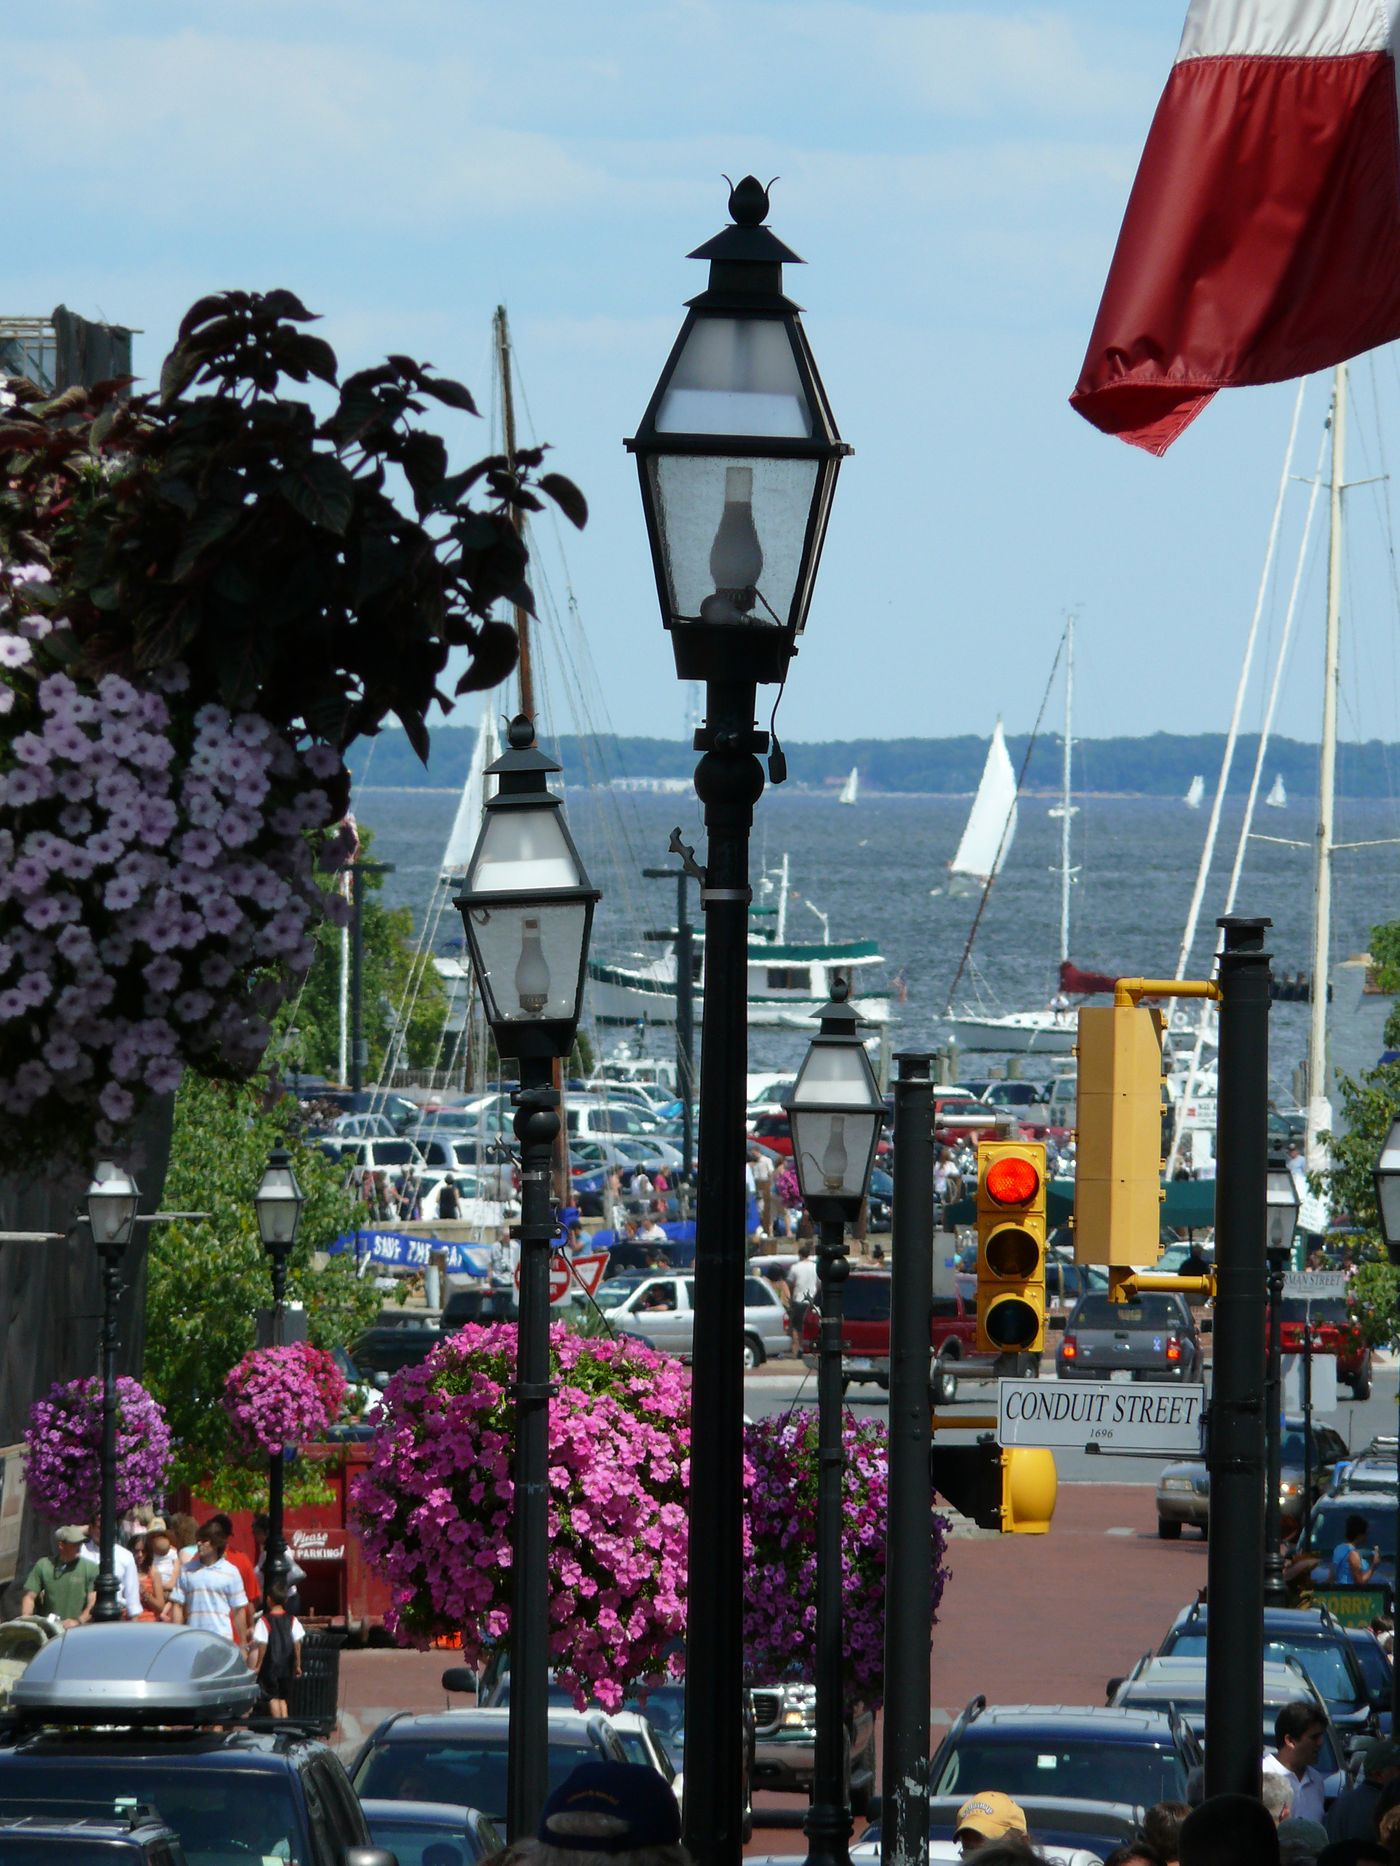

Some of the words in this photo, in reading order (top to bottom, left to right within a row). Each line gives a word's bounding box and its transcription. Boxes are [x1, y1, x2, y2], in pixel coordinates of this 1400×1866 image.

[1309, 1275, 1341, 1287] STREET
[1006, 1392, 1110, 1422] CONDUIT
[1112, 1395, 1198, 1425] STREET
[1089, 1428, 1114, 1440] 1696
[292, 1529, 329, 1547] Please
